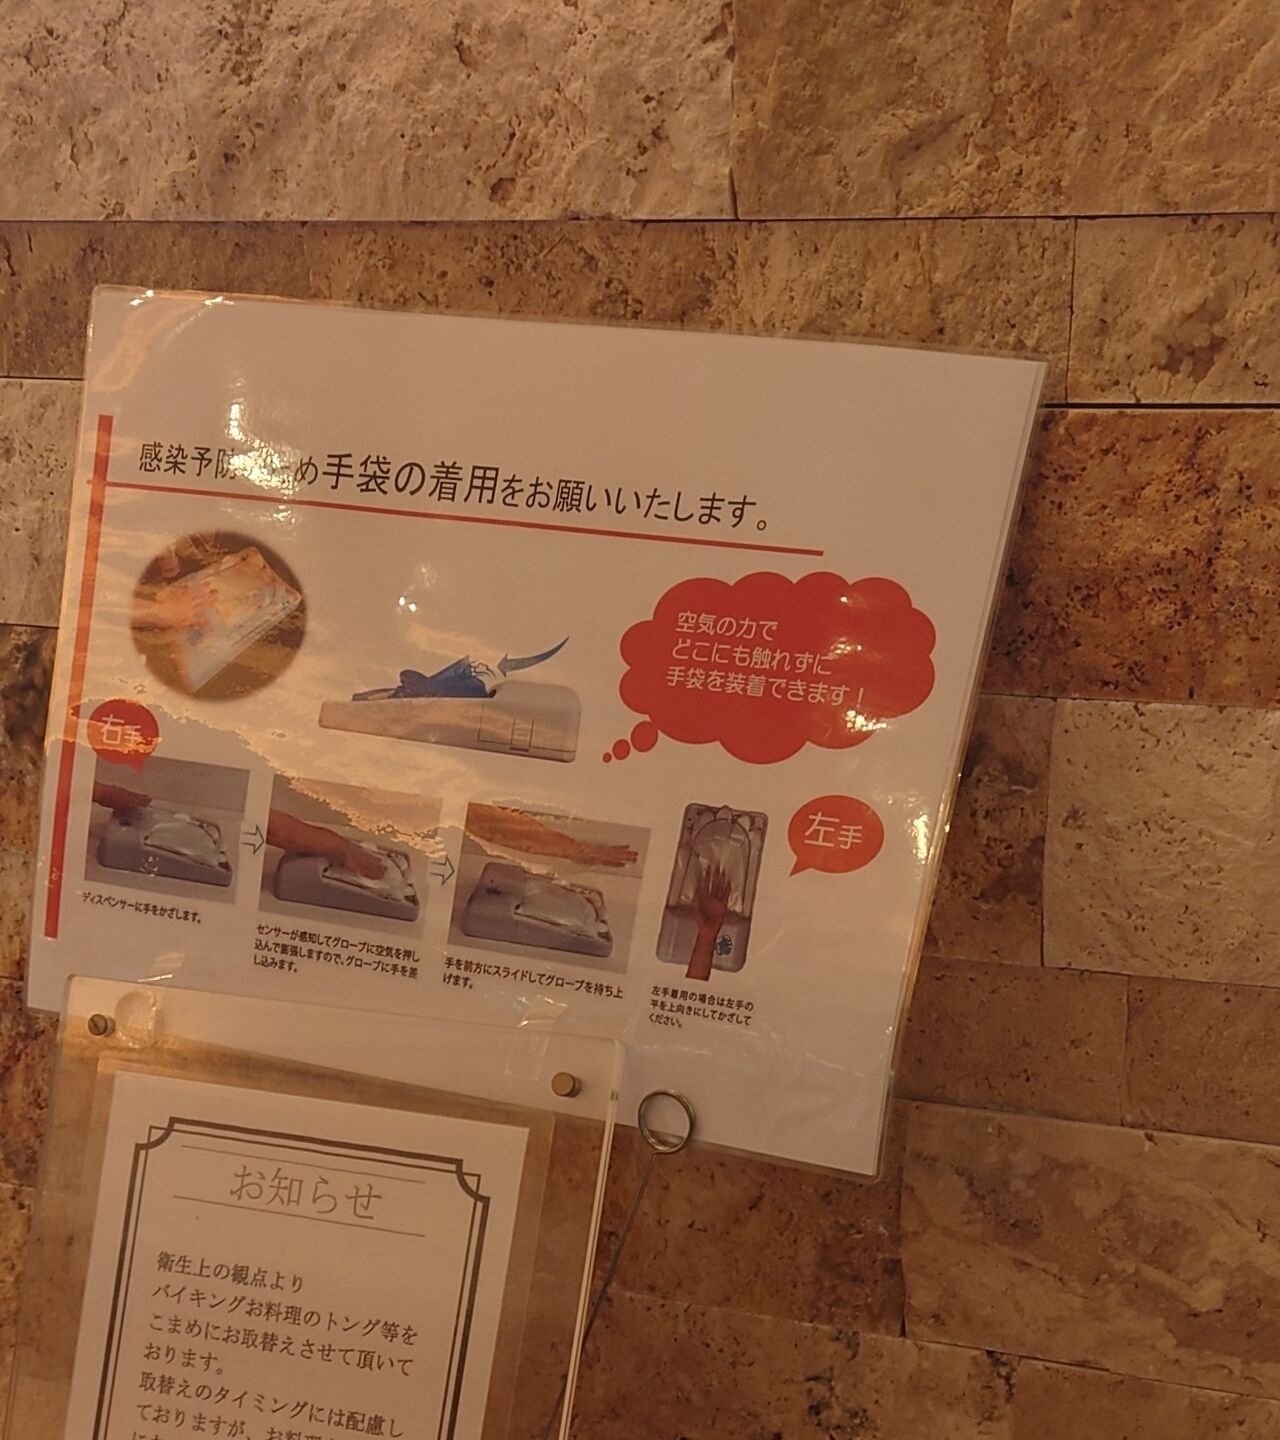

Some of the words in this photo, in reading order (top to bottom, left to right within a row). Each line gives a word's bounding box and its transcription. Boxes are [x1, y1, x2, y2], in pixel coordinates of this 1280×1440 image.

[138, 441, 767, 531] 感染予防め手袋の着用をお願いいたします。
[675, 611, 778, 641] 空気の力で
[671, 638, 833, 675] どこにも触れずに
[100, 713, 144, 752] 右手
[804, 811, 863, 850] 左手
[82, 891, 201, 924] ディスペンサーに手をかざします。
[256, 923, 421, 963] センサーが感知してグローブに空気を押し
[253, 954, 298, 973] し込みます。
[442, 973, 473, 989] げます。
[444, 956, 624, 999] 手を前方にスライドしてグローブを持ち上
[649, 999, 752, 1026] 平を上向きにしてかざして
[651, 986, 754, 1011] 左手着用の場合は左手の
[648, 1012, 683, 1028] ください。
[230, 1164, 383, 1219] お知らせ
[156, 1251, 303, 1293] 衛生上の観点より
[152, 1284, 418, 1346] バイキングお料理のトング等を
[143, 1342, 223, 1375] おります。
[149, 1313, 414, 1377] こまめにお取替えさせて頂いて
[139, 1371, 403, 1438] 取替えのタイミングには配慮し
